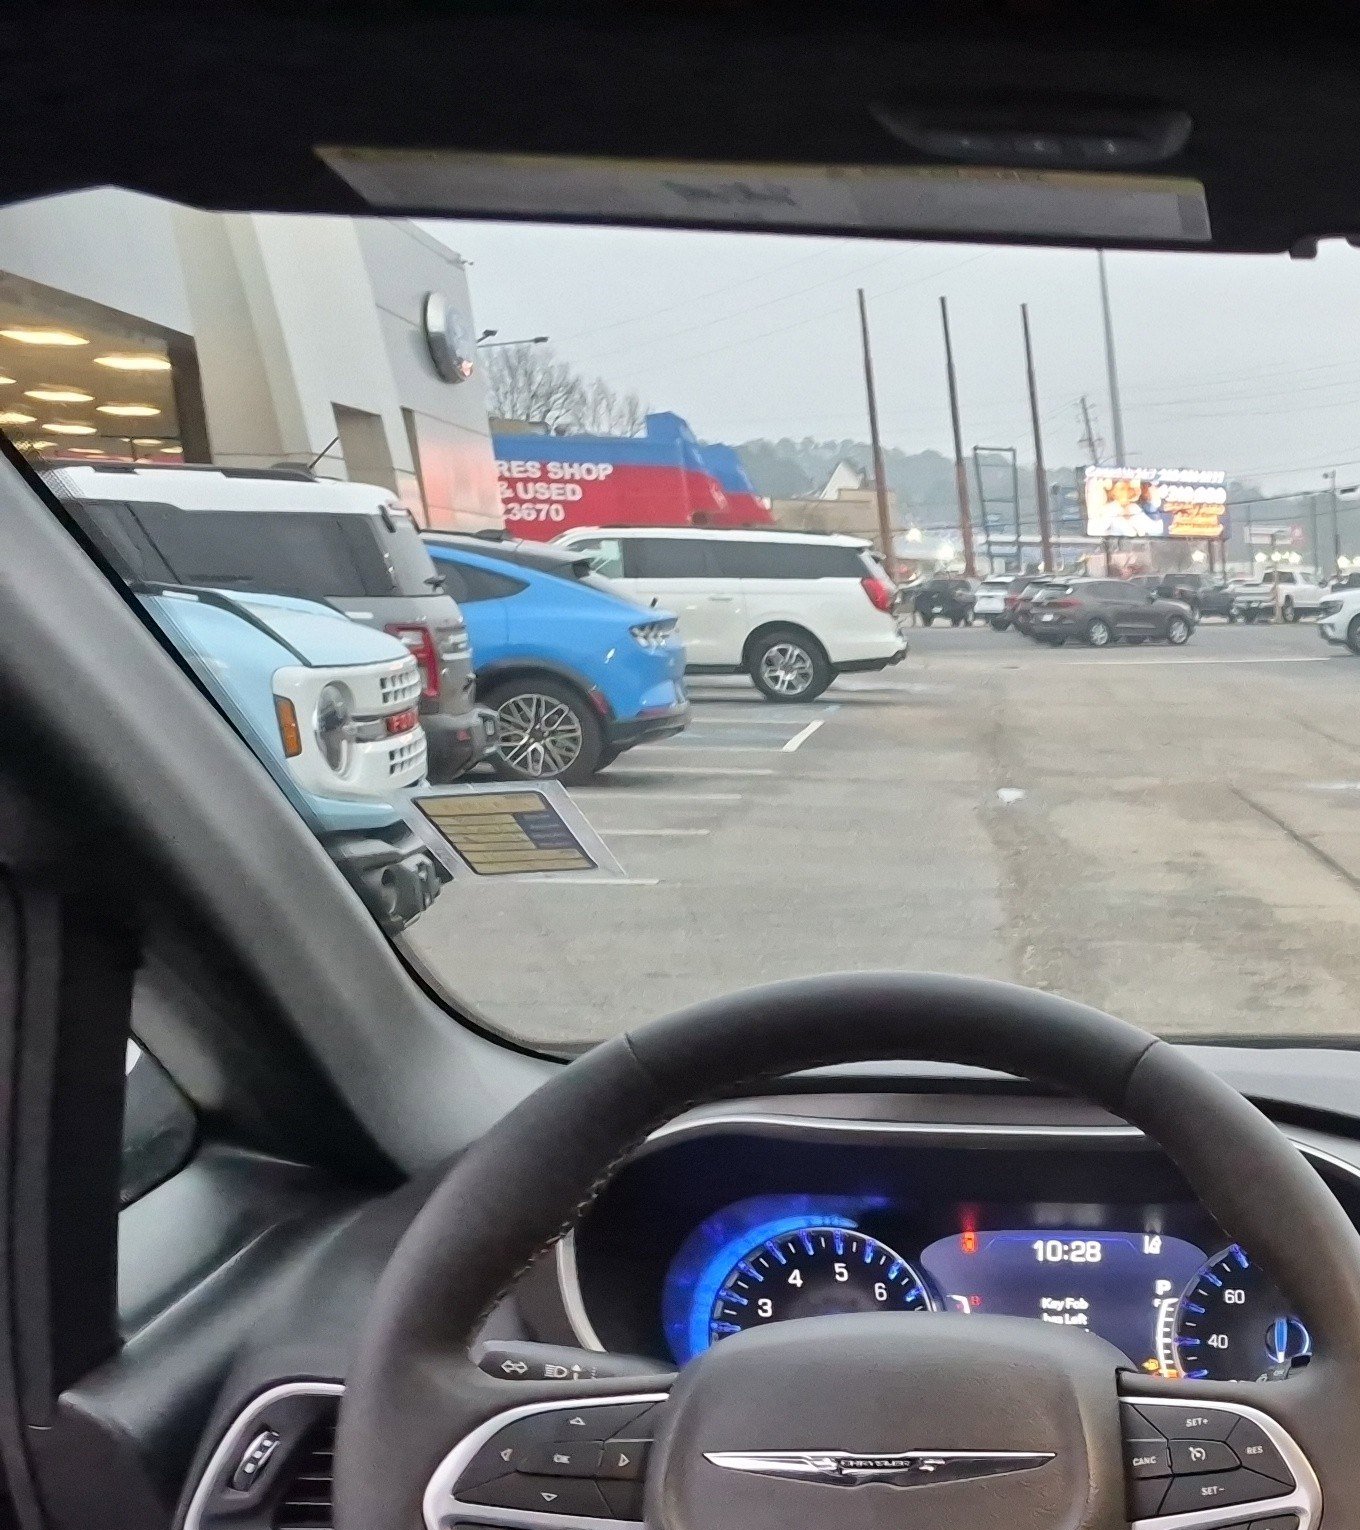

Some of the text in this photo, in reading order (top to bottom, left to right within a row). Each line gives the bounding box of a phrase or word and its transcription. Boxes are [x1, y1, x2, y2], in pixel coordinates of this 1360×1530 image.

[546, 462, 613, 480] SHOP
[516, 482, 582, 500] USED
[1033, 1240, 1102, 1262] 10:28
[788, 1269, 803, 1287] 4
[834, 1263, 848, 1281] 5
[874, 1283, 888, 1300] 6
[1156, 1279, 1172, 1295] P
[1041, 1298, 1089, 1310] Key Fob
[1225, 1289, 1245, 1304] 60
[757, 1299, 772, 1317] 3
[1208, 1334, 1228, 1349] 40
[1246, 1445, 1263, 1454] RES
[1132, 1456, 1157, 1466] CANC
